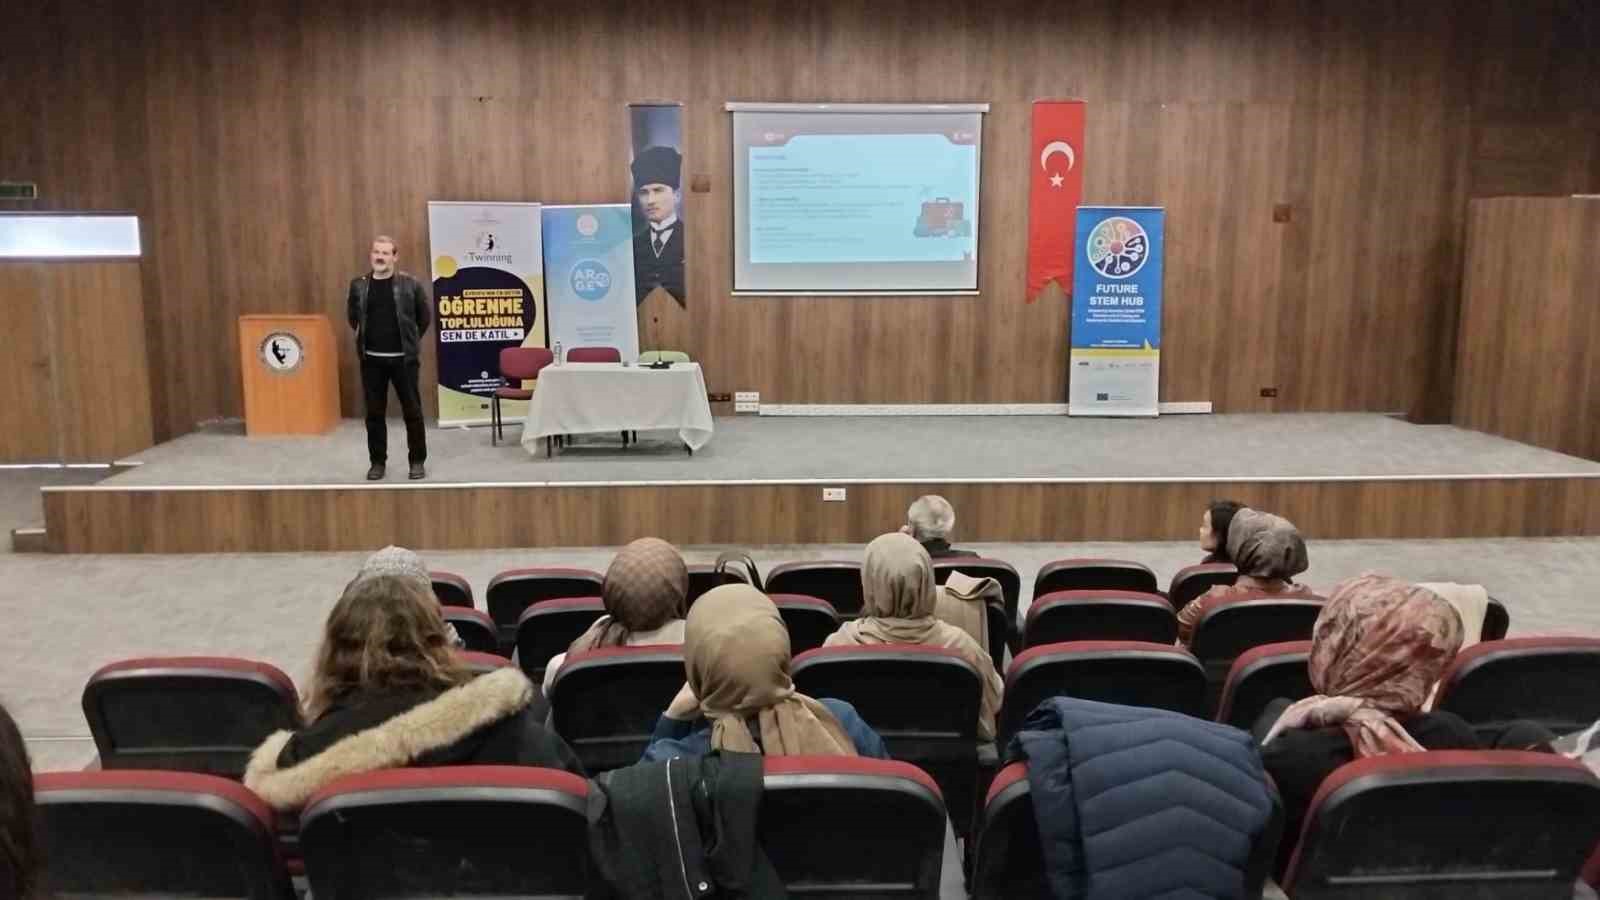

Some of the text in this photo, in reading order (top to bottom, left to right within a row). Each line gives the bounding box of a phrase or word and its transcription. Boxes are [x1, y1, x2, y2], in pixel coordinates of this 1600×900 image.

[1096, 284, 1139, 294] FUTURE
[439, 296, 524, 316] ÖĞRENME
[1089, 296, 1144, 306] STEM HUB
[440, 315, 524, 329] TOPLULUĞUNA
[442, 330, 510, 340] SEN DE KATIL
